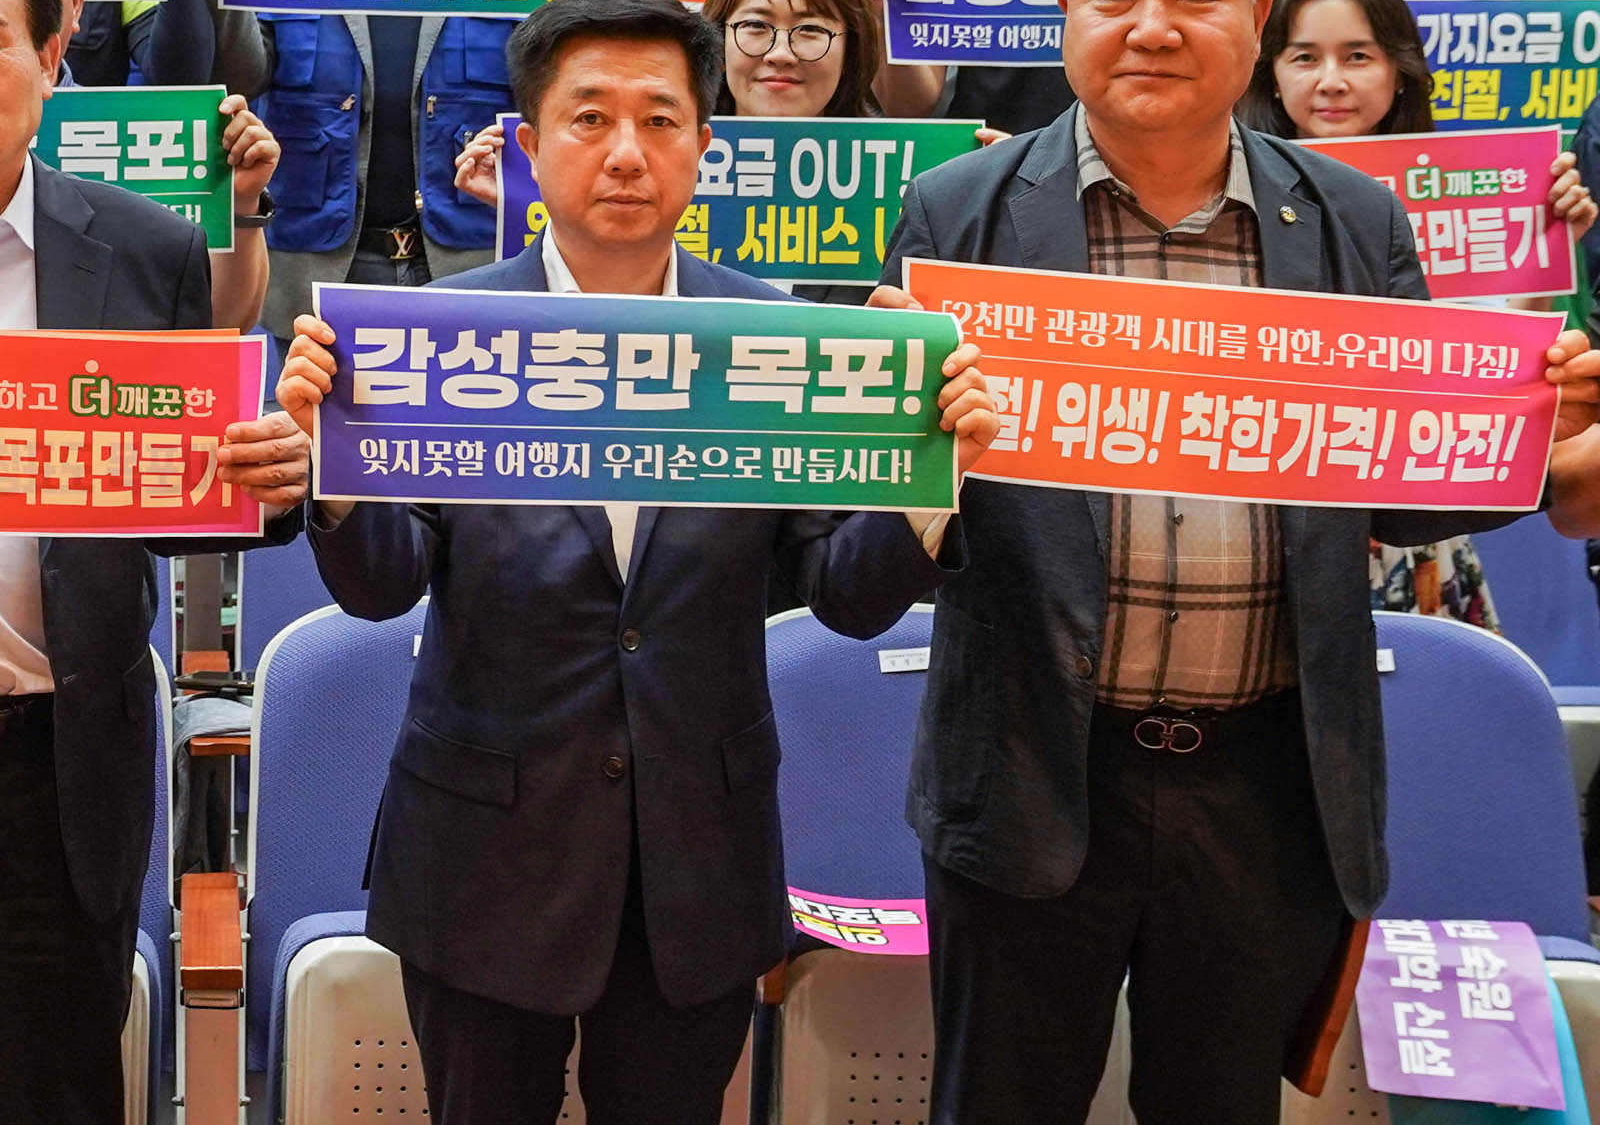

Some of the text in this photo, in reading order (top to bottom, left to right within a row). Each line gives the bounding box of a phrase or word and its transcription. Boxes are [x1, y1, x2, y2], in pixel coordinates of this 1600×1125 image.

[909, 21, 1061, 49] 잊지못할 여행지
[1430, 68, 1510, 121] 친절,
[57, 118, 208, 182] 목포!
[789, 137, 915, 200] OUT!
[1405, 152, 1527, 200] 더 깨끗한
[737, 204, 860, 266] 서비스
[352, 326, 926, 417] 감성충만 목포!
[1043, 307, 1142, 351] 관광객
[1148, 315, 1248, 360] 시대를
[1440, 341, 1520, 379] 다짐!
[68, 359, 112, 419] 더
[116, 384, 217, 418] 깨끗한
[359, 436, 913, 484] 잊지못할 여행지 우리손으로 만듭시다!
[1051, 380, 1527, 484] 위생! 착한가격! 안전!
